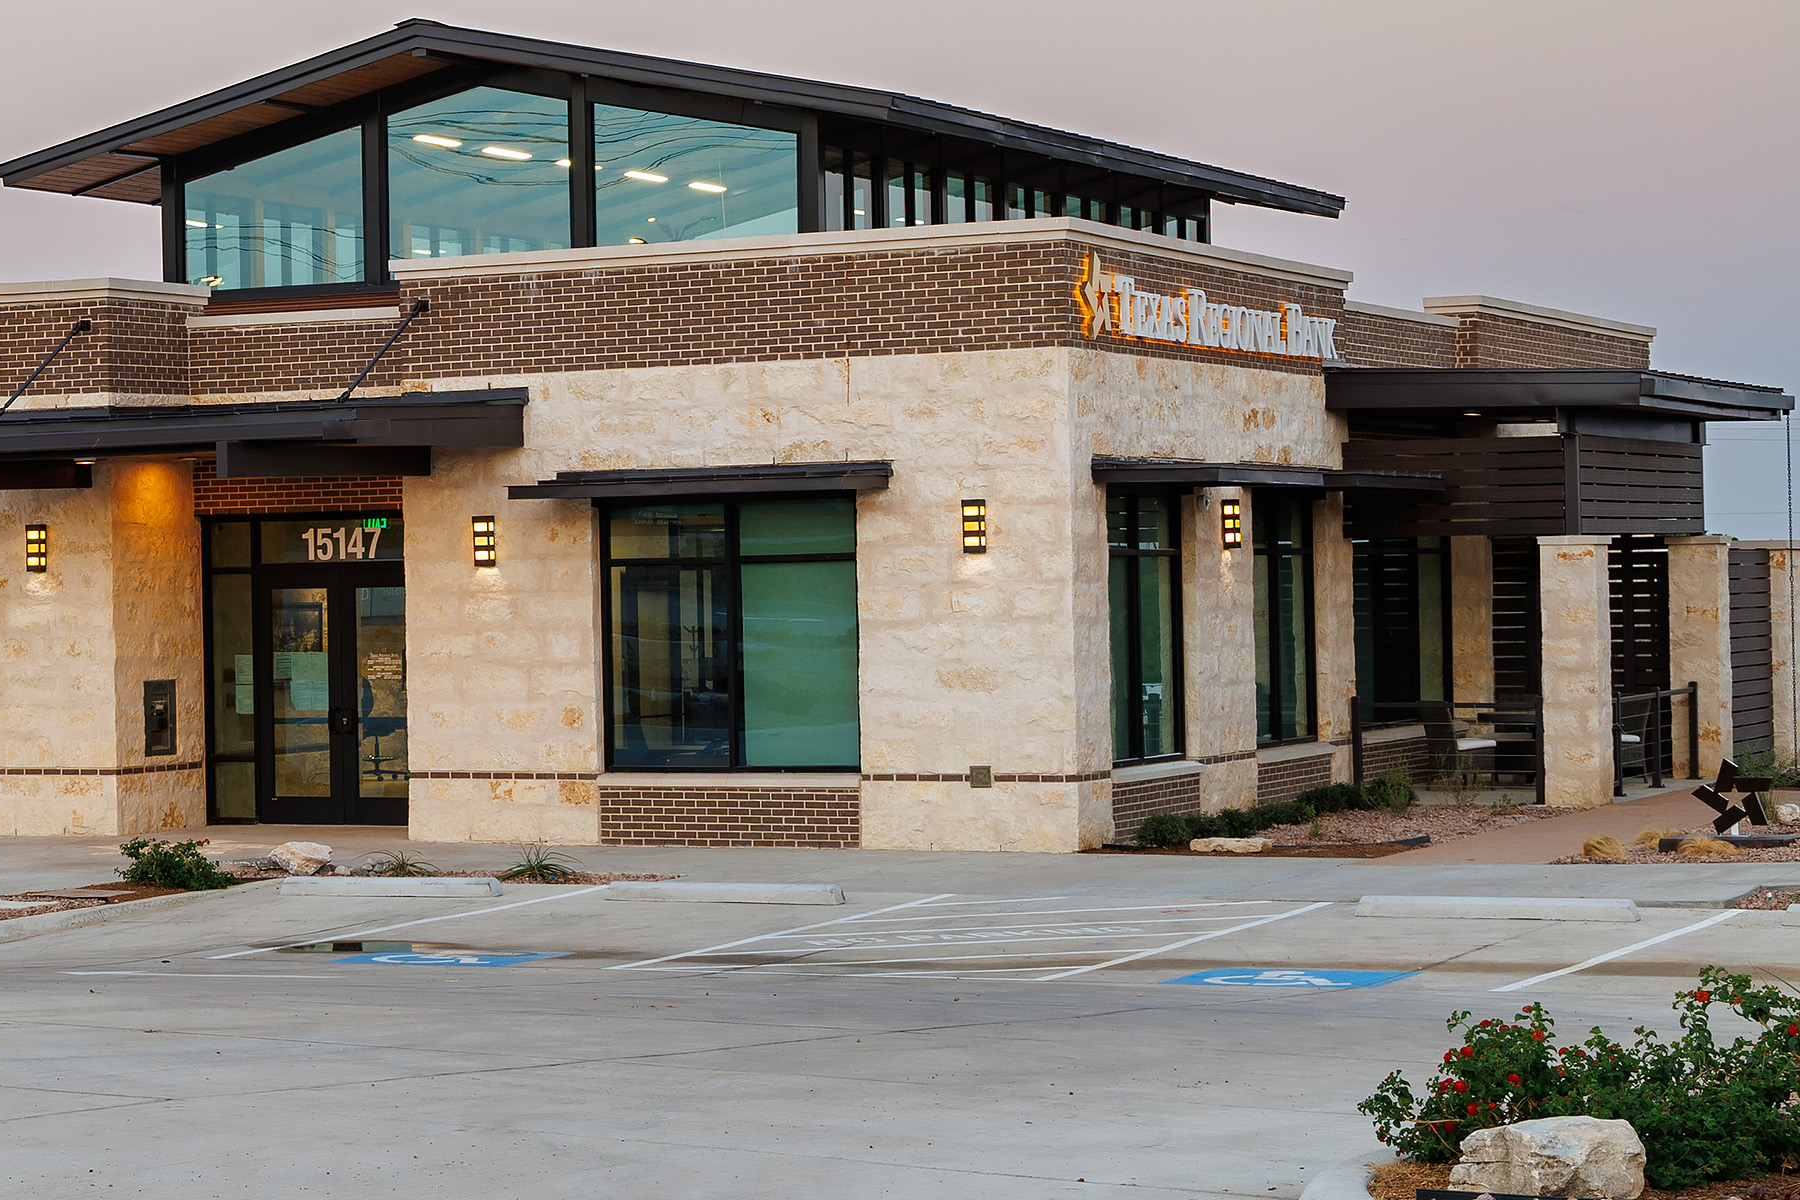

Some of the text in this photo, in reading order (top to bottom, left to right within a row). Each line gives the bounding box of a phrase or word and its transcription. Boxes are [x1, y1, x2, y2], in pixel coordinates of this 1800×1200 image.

[1114, 275, 1338, 359] TEXAS REGIONAL BANK
[302, 527, 381, 560] 15147
[802, 926, 1142, 946] NO PARKING
